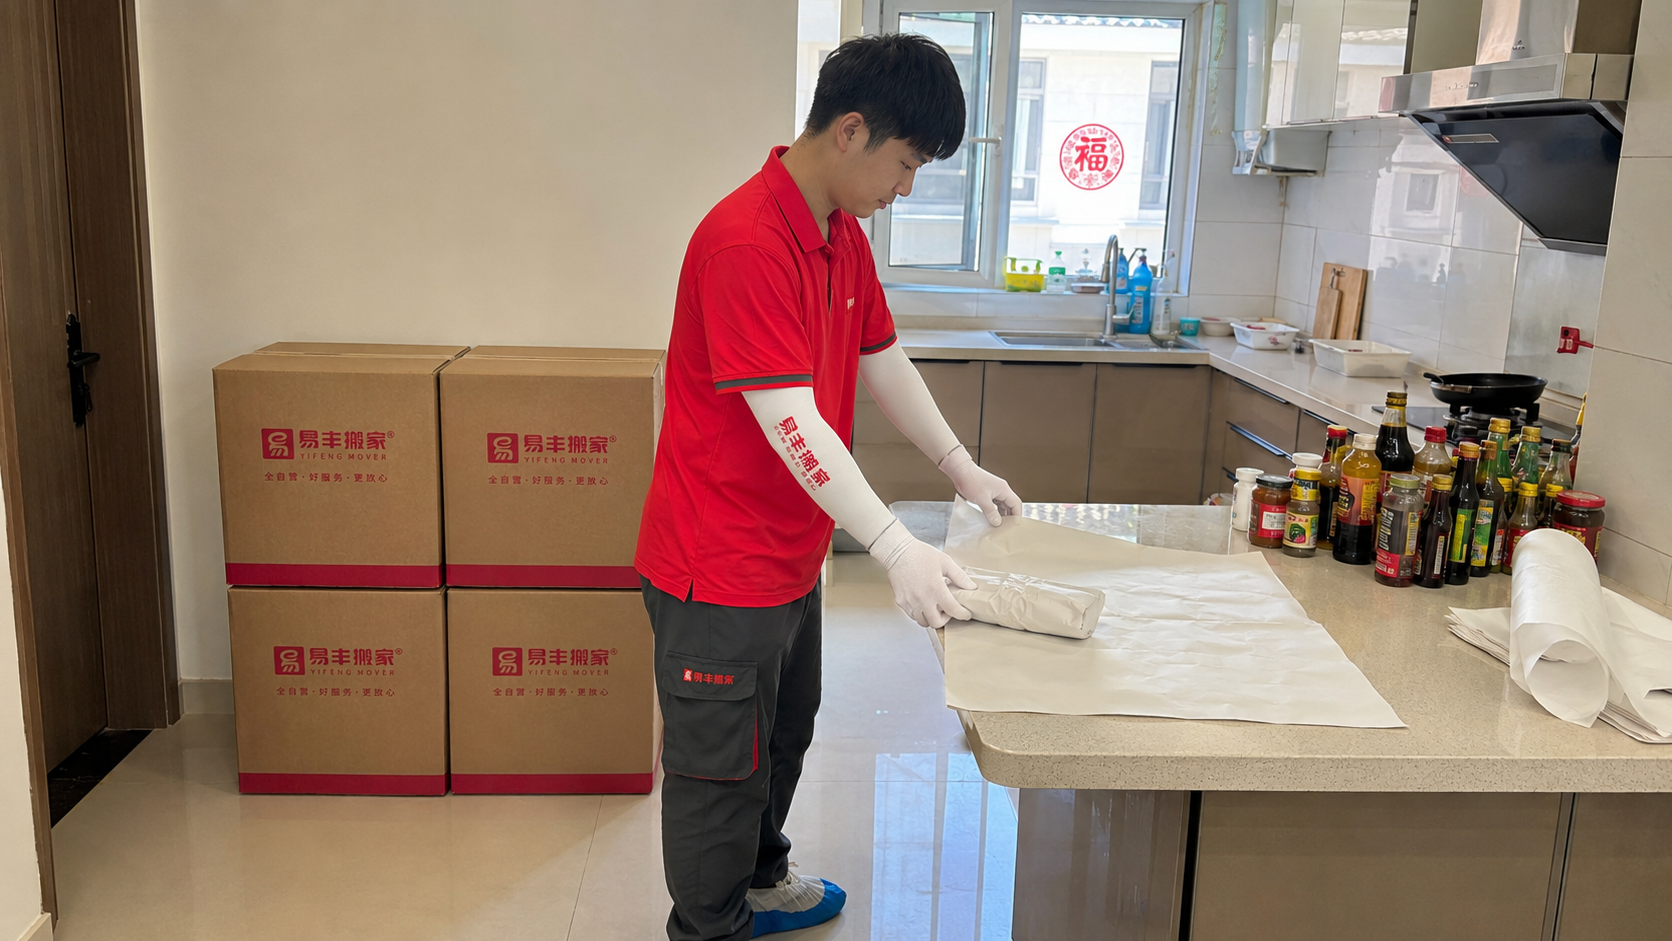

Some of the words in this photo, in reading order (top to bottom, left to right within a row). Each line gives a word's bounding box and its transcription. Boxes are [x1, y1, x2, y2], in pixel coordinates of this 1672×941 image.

[1074, 136, 1109, 172] 福
[348, 453, 386, 461] MOVER
[524, 456, 566, 464] YIFENG
